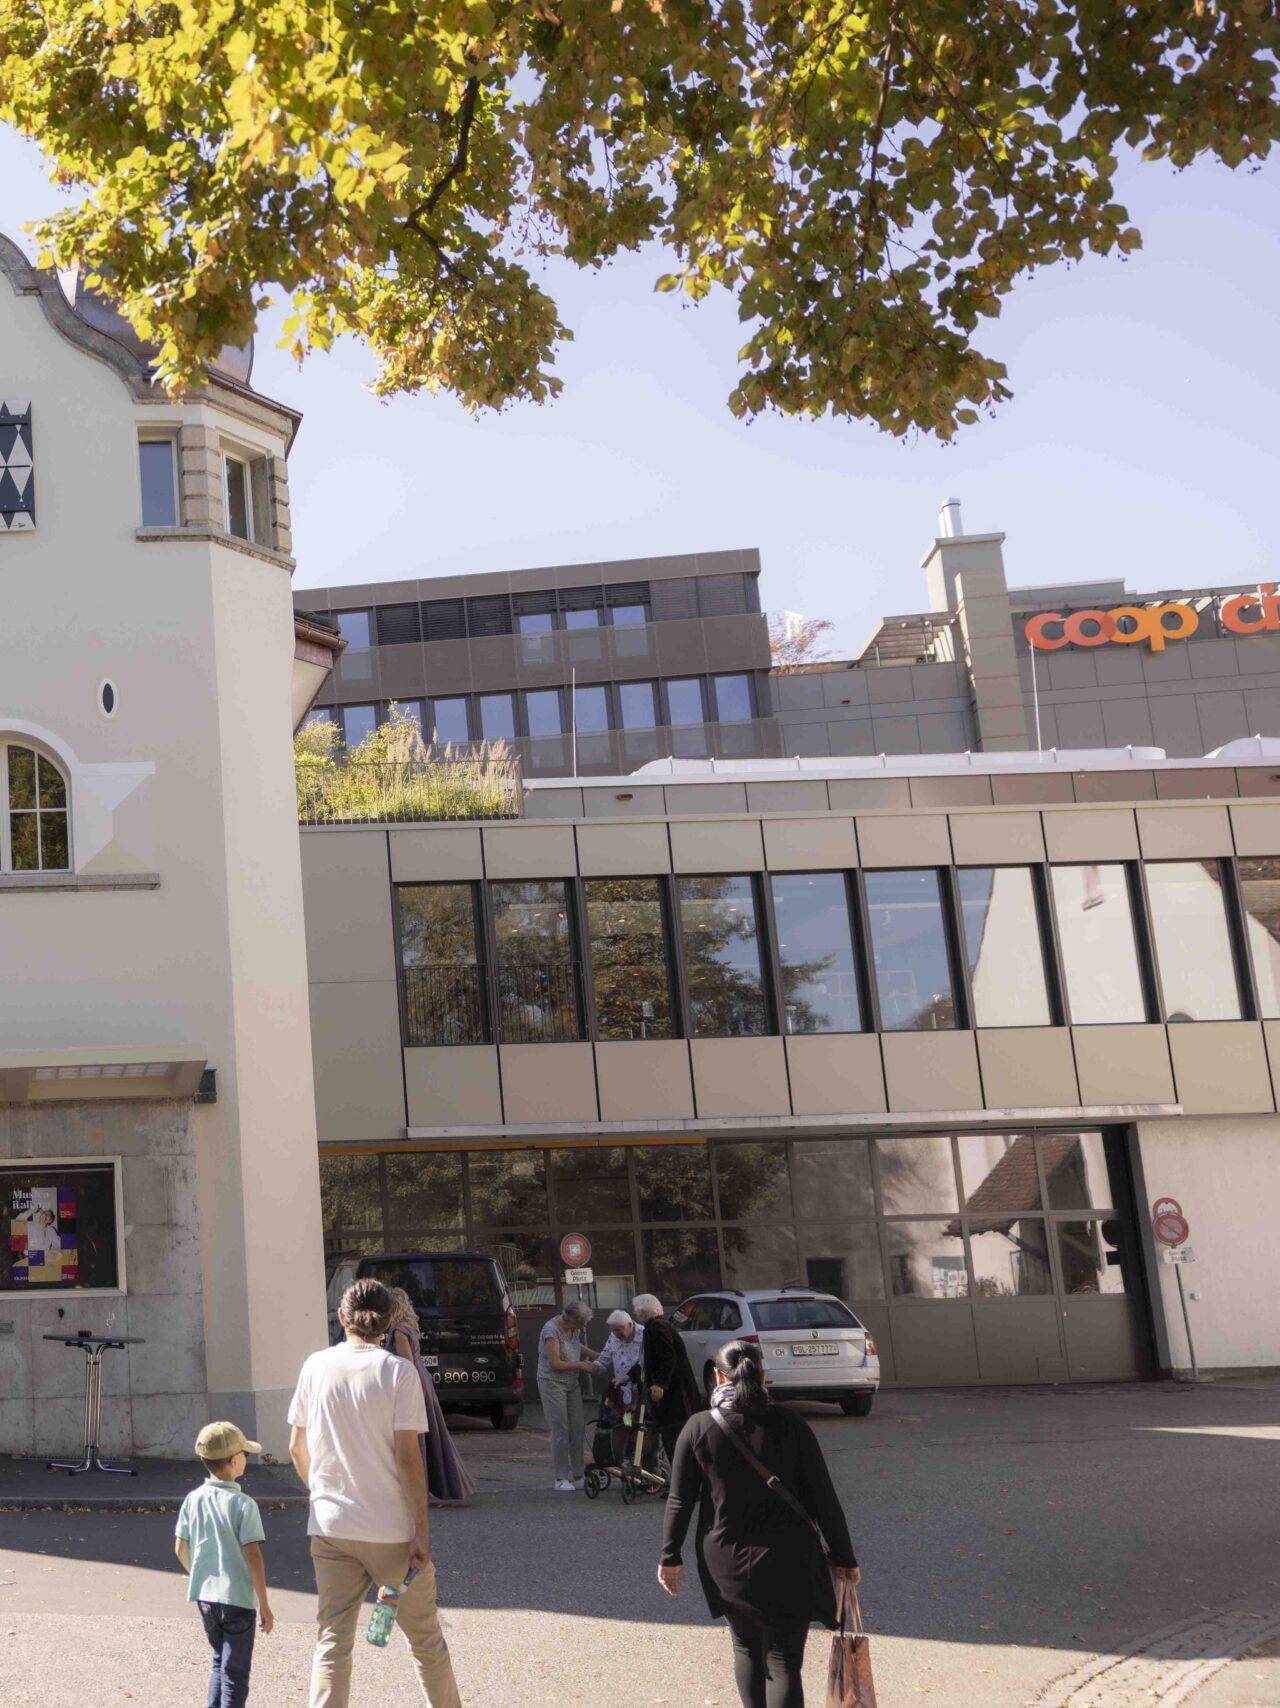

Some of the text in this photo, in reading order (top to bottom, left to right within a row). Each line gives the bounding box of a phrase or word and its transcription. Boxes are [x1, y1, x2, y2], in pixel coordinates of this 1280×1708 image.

[1025, 583, 1280, 652] coop ci
[444, 1371, 469, 1383] 800
[471, 1370, 496, 1382] 990
